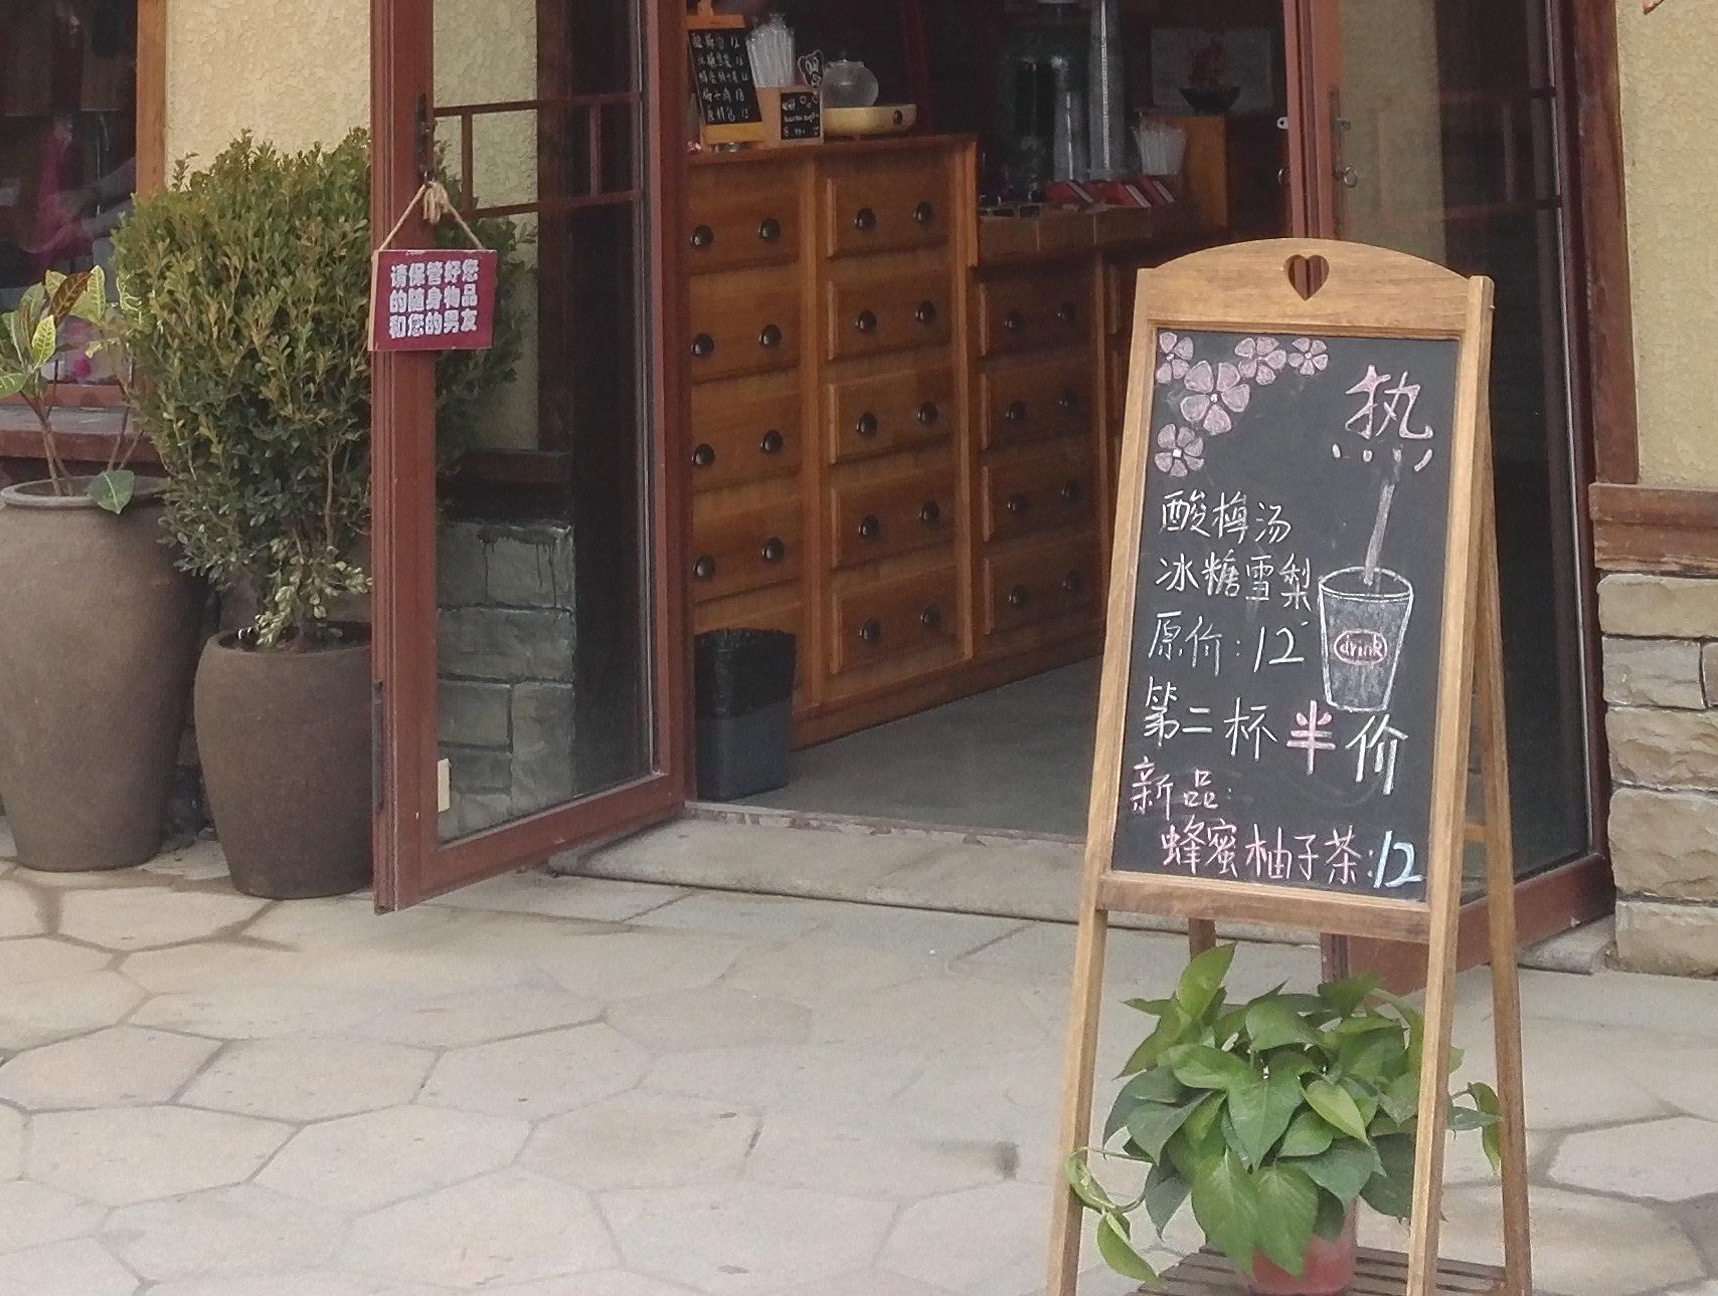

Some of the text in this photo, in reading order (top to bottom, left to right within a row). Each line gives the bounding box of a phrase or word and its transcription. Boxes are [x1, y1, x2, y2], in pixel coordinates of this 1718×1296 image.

[389, 283, 479, 314] 的随身物品
[388, 308, 478, 339] 和您的男友
[1160, 490, 1293, 545] 酸梅汤
[1155, 552, 1313, 613] 冰糖雪梨
[1339, 633, 1384, 658] drink
